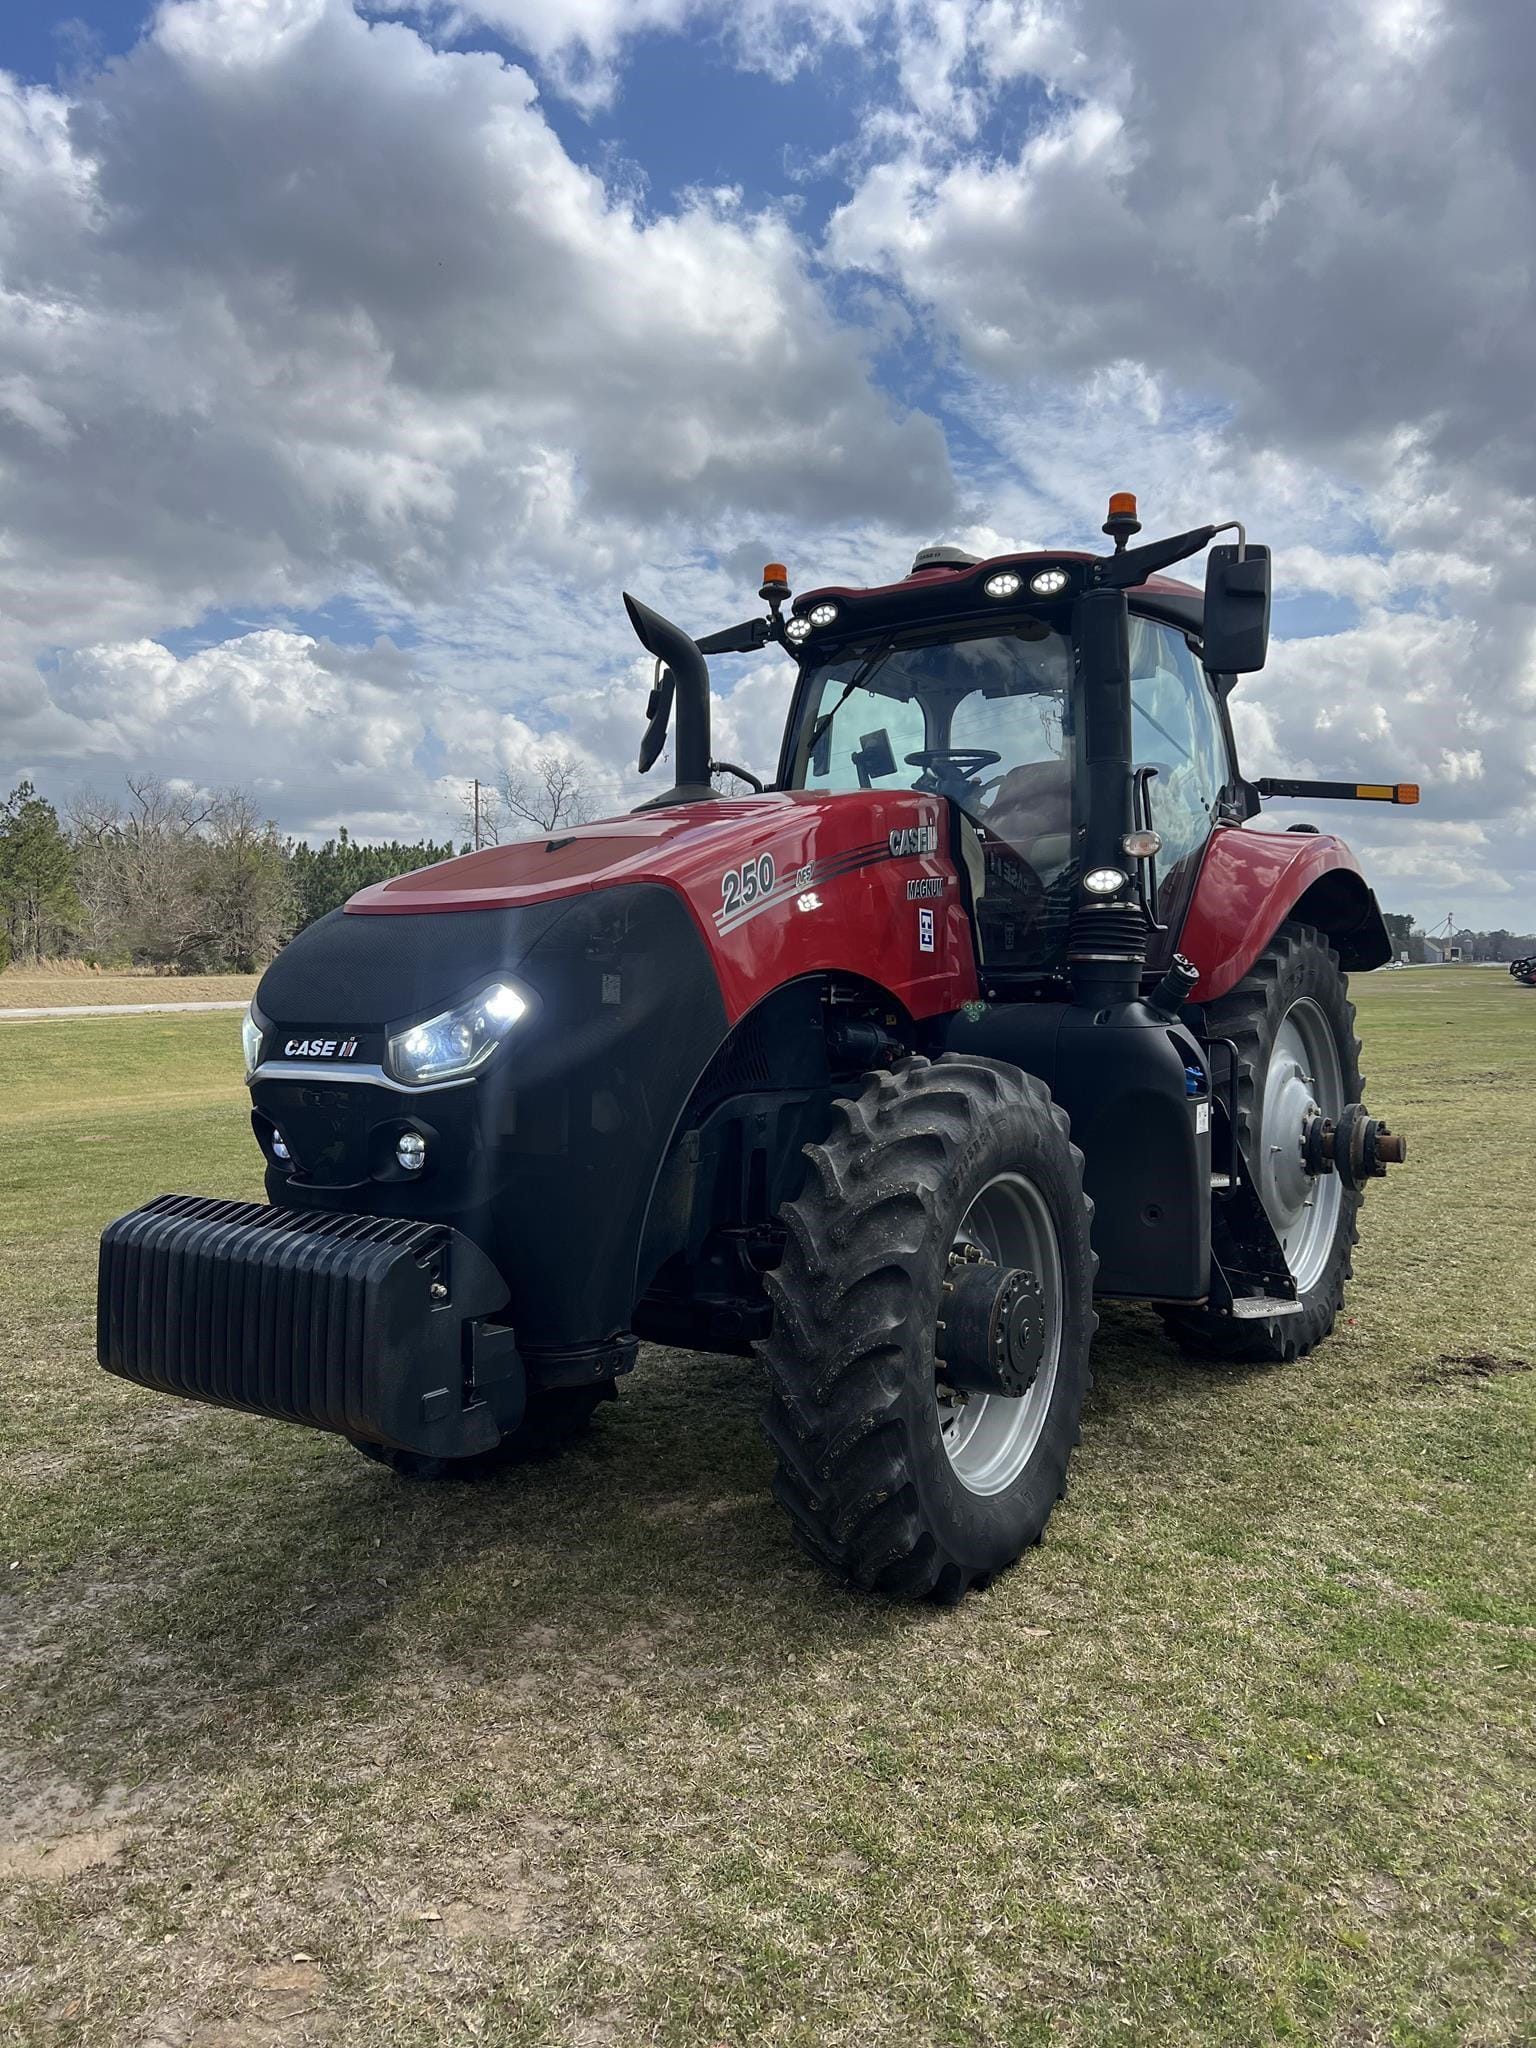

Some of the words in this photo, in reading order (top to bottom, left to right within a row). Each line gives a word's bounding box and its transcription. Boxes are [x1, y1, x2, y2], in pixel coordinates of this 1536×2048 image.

[889, 827, 928, 857] CASE
[721, 851, 776, 918] 250
[906, 877, 944, 901] MAGNUM
[284, 1039, 337, 1056] CASE
